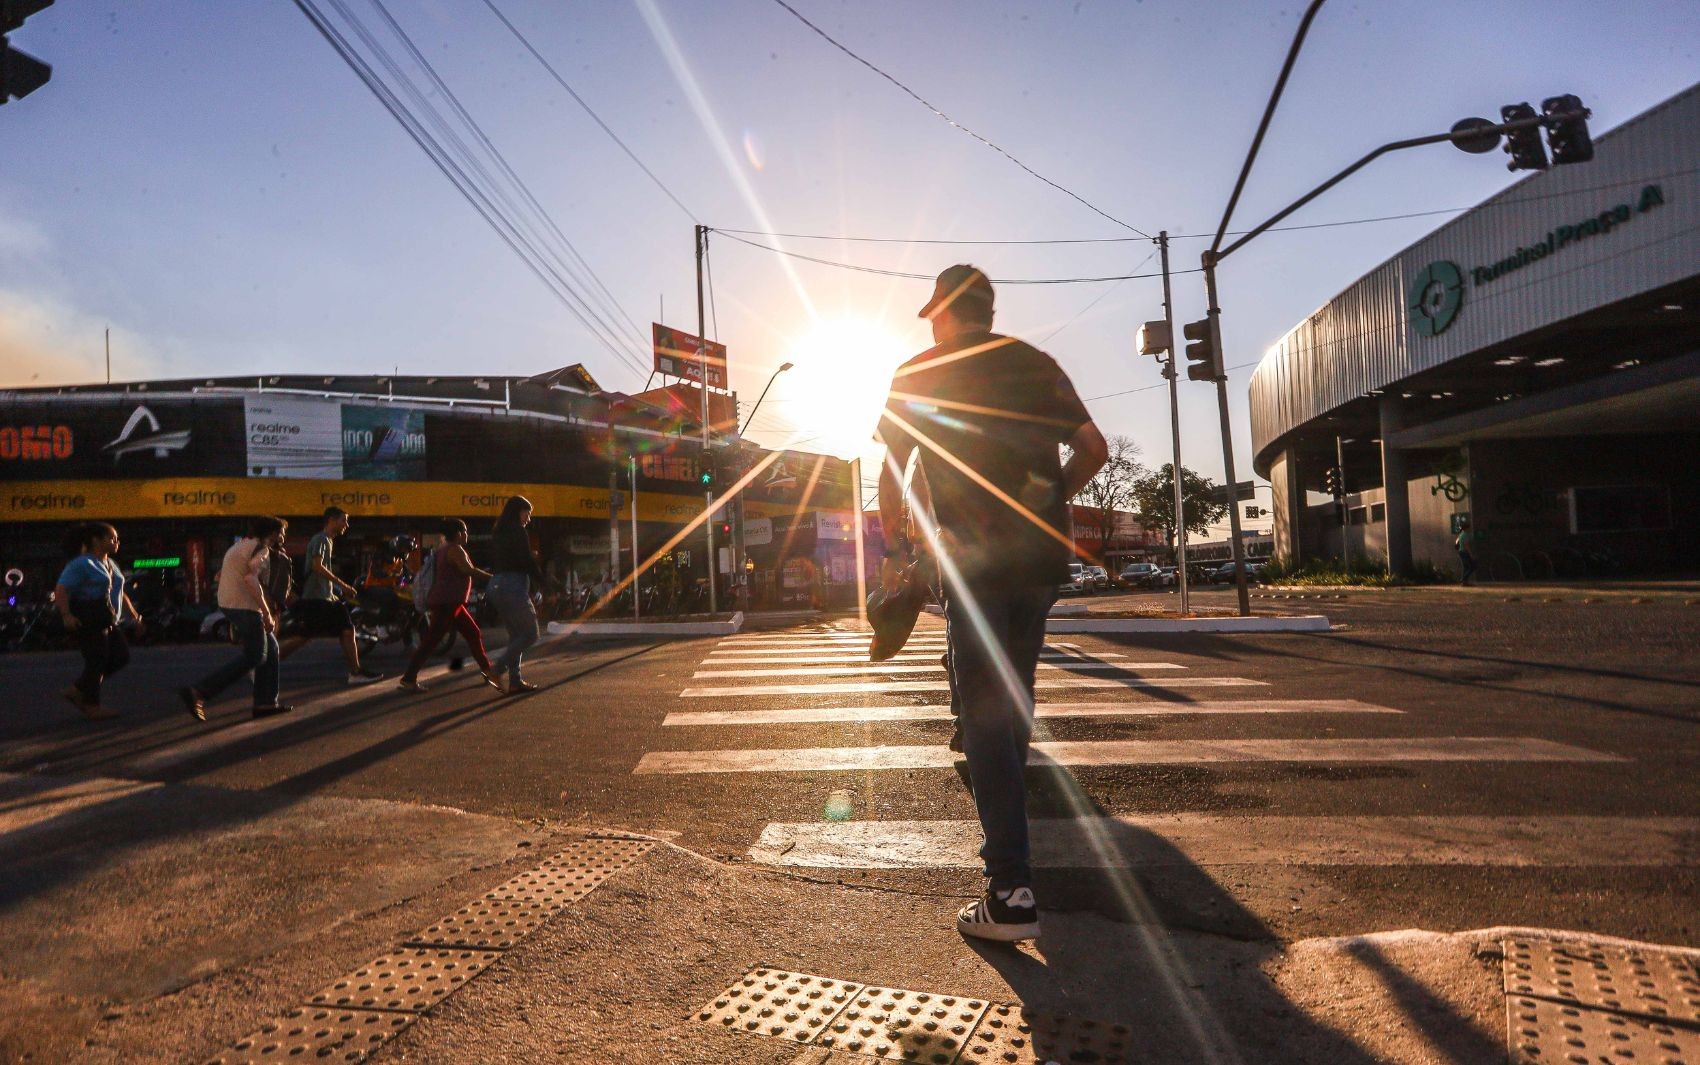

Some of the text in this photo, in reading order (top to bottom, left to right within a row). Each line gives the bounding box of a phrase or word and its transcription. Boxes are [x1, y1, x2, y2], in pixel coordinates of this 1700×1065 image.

[1469, 184, 1664, 287] Terminal Praça A
[251, 422, 300, 434] realme
[11, 492, 86, 511] realme
[163, 489, 237, 505] realme
[320, 489, 392, 505] realme
